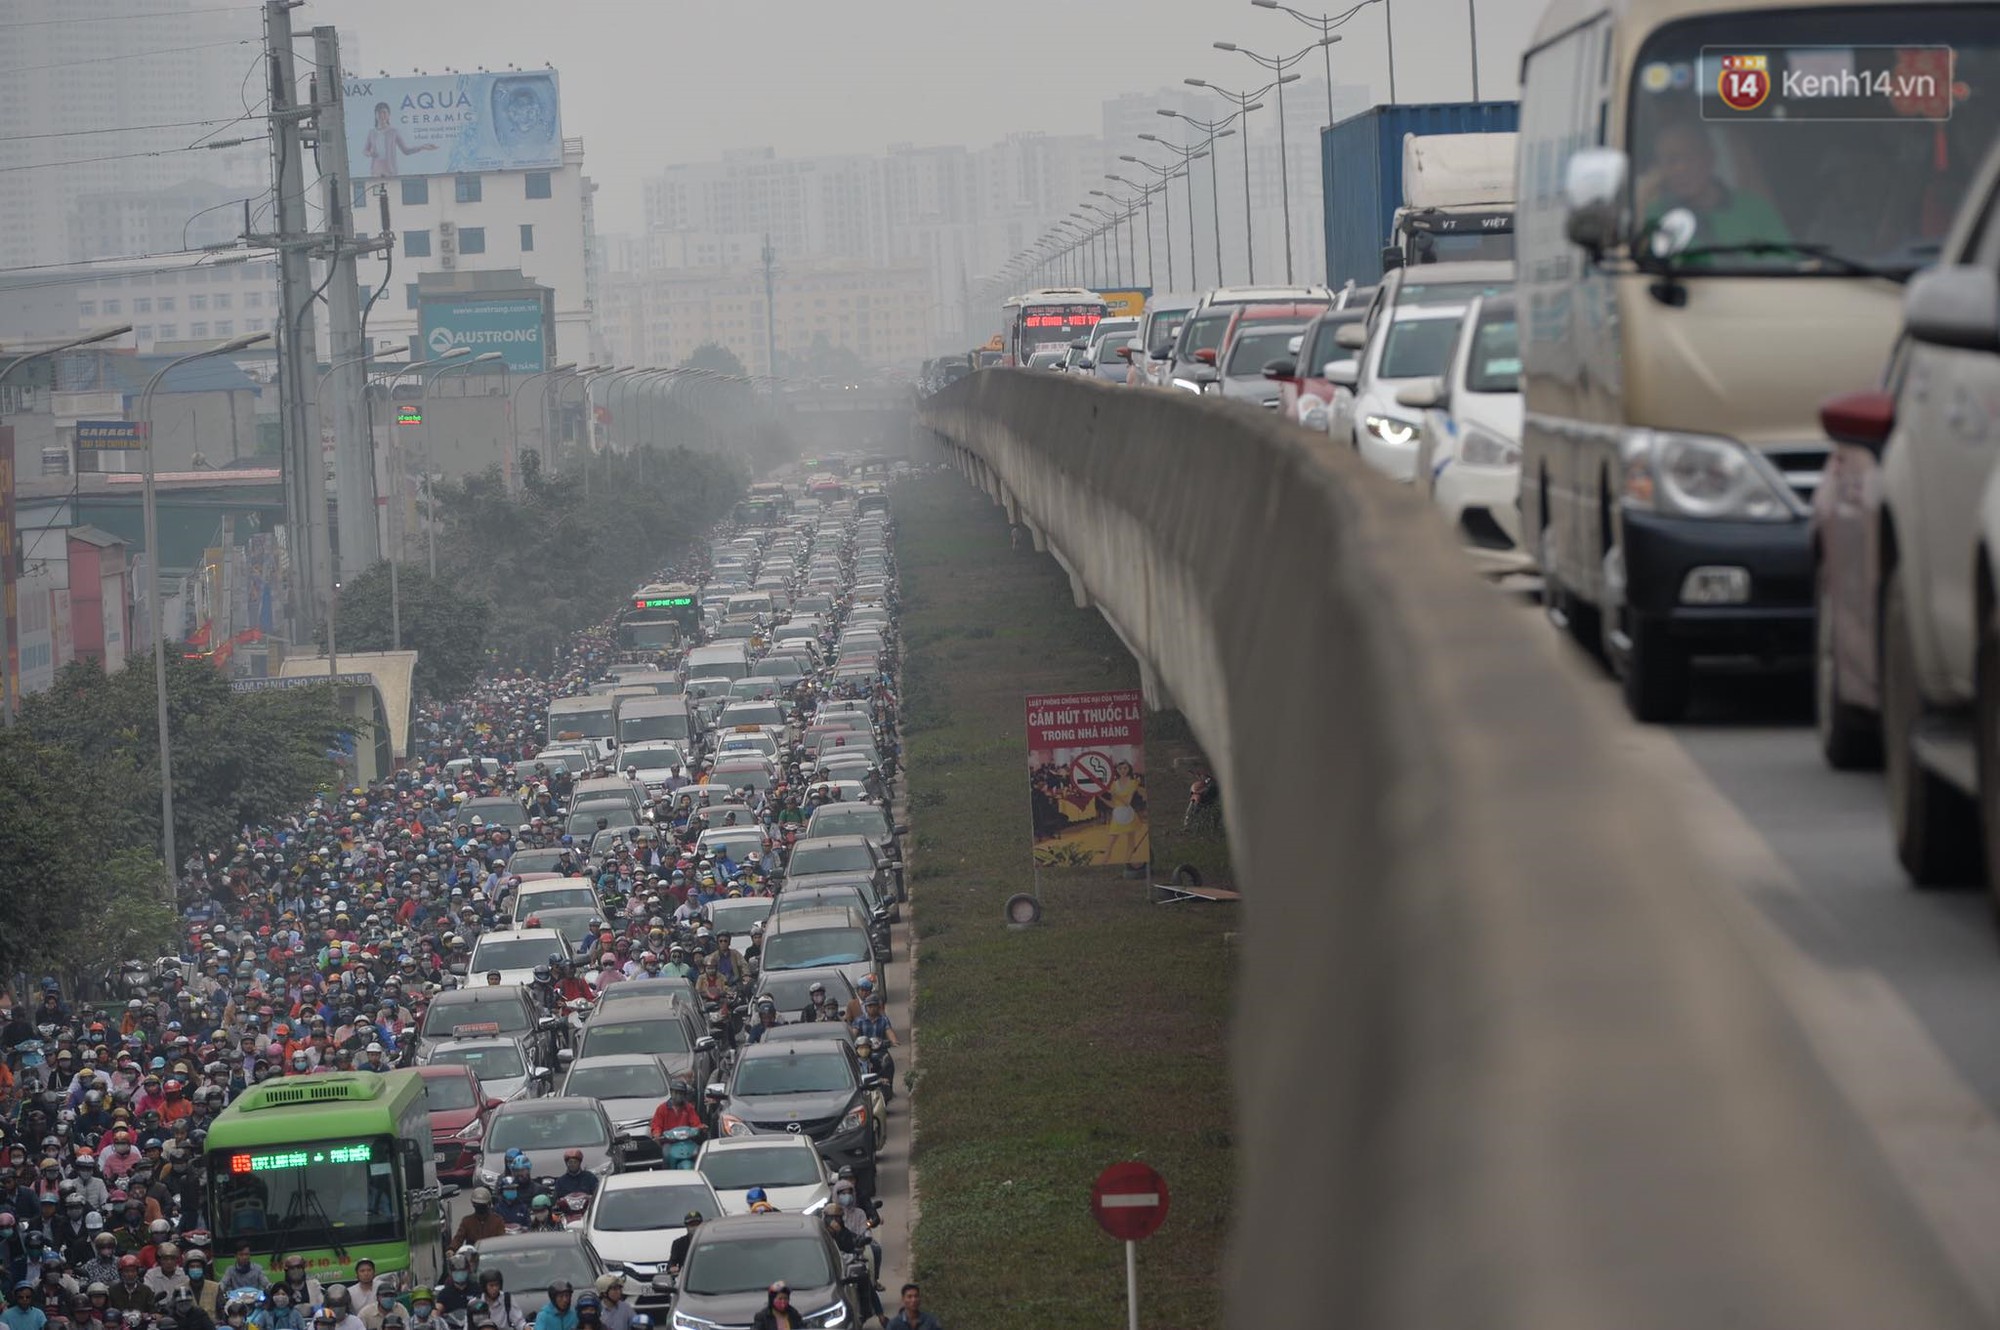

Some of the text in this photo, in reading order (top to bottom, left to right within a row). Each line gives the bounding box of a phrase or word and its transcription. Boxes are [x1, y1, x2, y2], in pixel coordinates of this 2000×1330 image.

[342, 83, 373, 97] NAX
[400, 91, 472, 110] AQUA
[400, 112, 473, 124] CERAMIC
[454, 329, 538, 344] AUSTRONG
[80, 428, 135, 437] GARAGE
[1029, 707, 1054, 726] CẤM
[1057, 707, 1080, 725] HÚT
[1083, 702, 1122, 723] THUỐC
[1042, 724, 1129, 741] TRONG NHÀ HÀNG
[232, 1154, 251, 1172] 05
